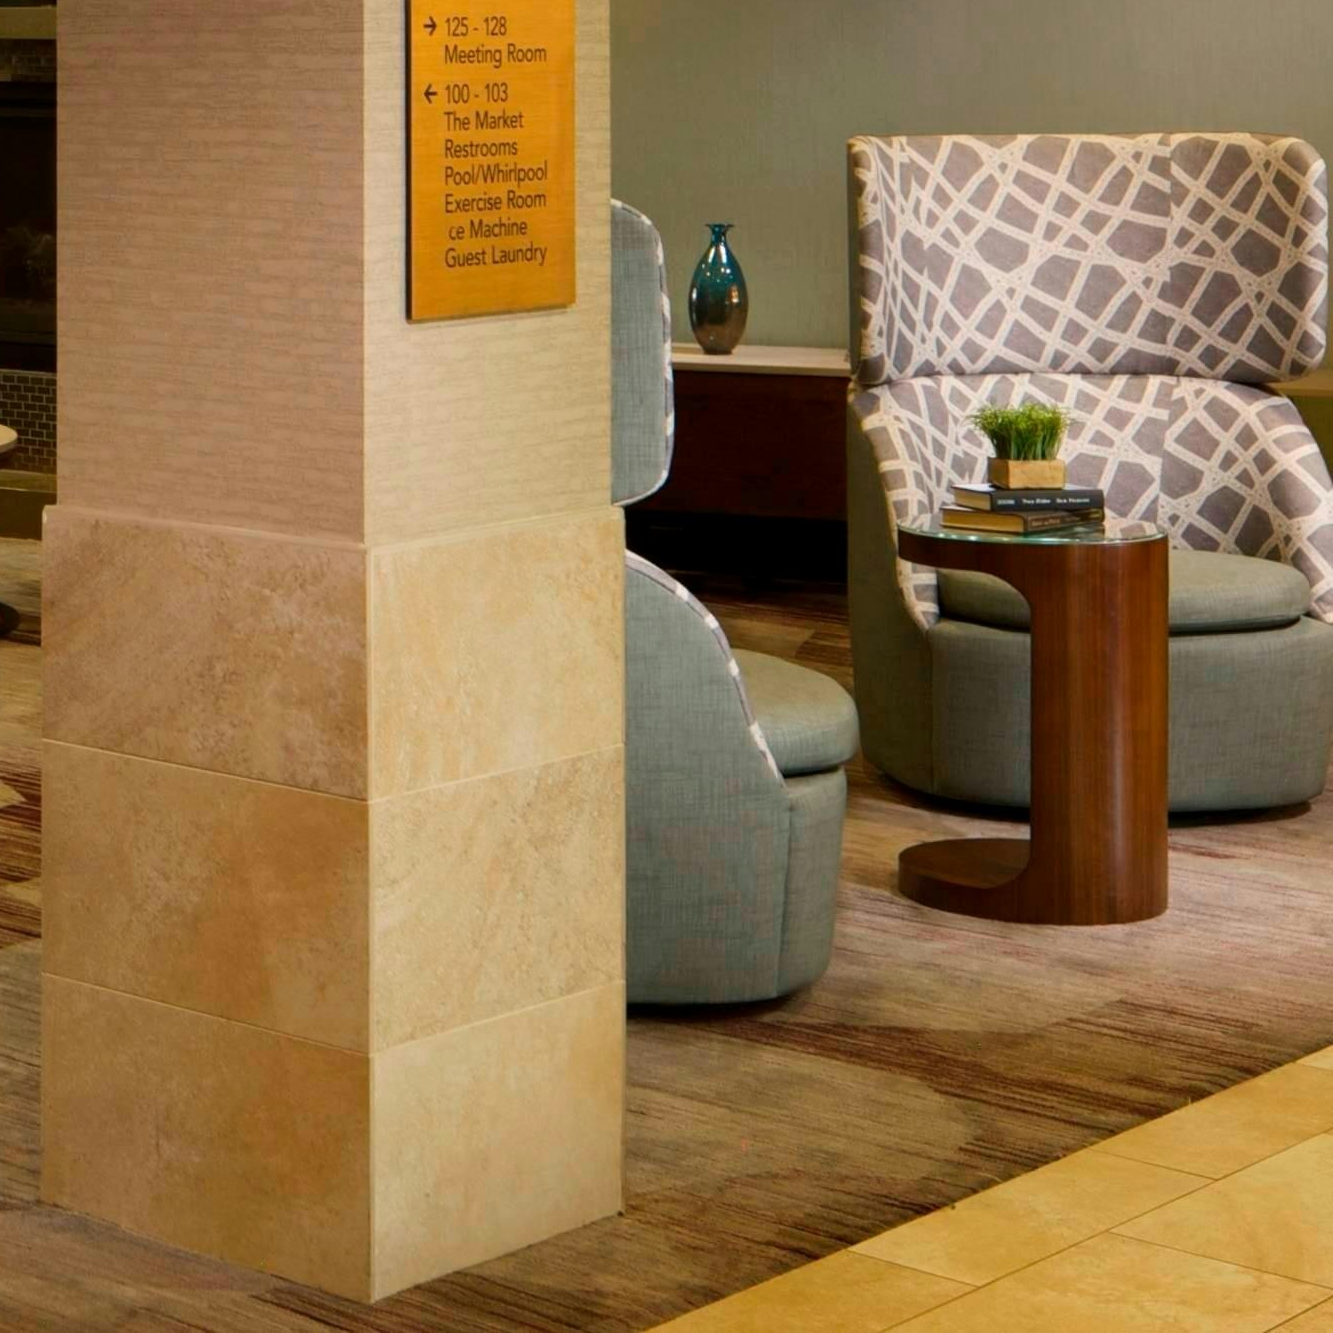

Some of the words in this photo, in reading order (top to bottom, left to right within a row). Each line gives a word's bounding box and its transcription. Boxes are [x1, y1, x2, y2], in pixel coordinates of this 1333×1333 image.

[444, 17, 469, 37] 125
[483, 16, 507, 36] 128
[444, 43, 502, 68] Meeting
[506, 43, 547, 63] Room
[444, 84, 470, 104] 100
[484, 82, 508, 103] 103
[444, 111, 471, 131] The
[475, 111, 524, 130] Market
[444, 138, 518, 159] Restrooms
[444, 161, 548, 188] Pool/Whirlpool
[445, 192, 502, 214] Exercise
[506, 191, 547, 209] Room
[469, 218, 528, 239] Machine
[445, 246, 487, 268] Guest
[491, 242, 548, 265] Laundry
